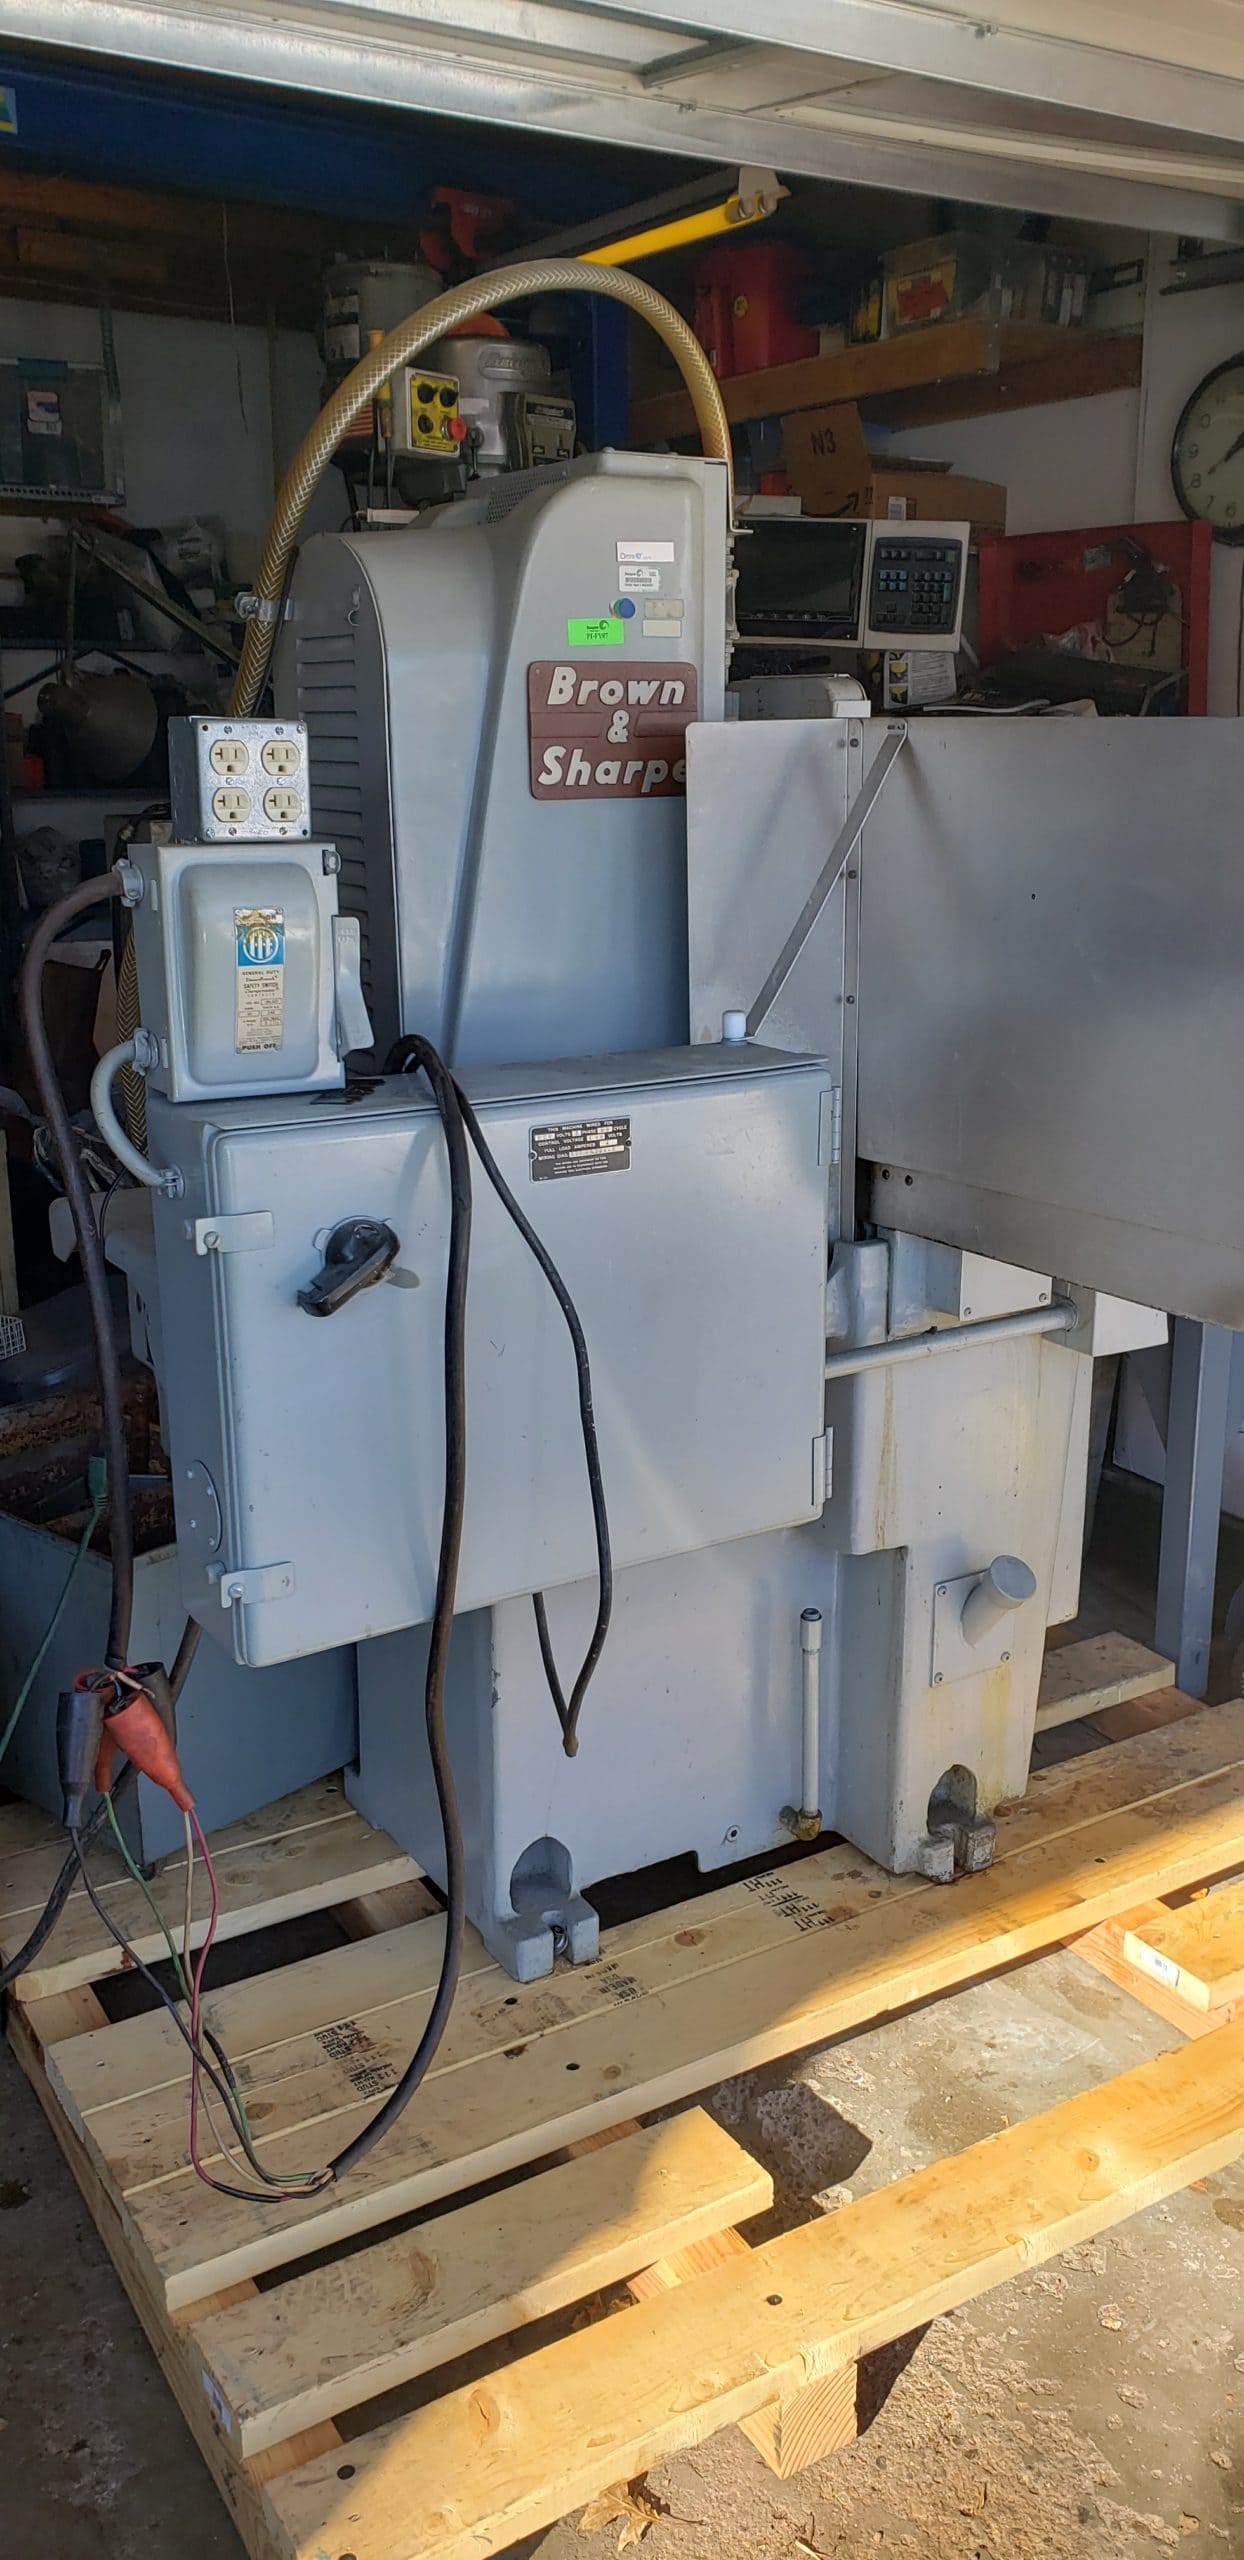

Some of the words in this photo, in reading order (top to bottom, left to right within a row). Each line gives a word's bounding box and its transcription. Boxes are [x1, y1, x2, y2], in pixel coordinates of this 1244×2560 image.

[810, 428, 837, 456] N3
[1190, 473, 1202, 488] 8
[547, 666, 686, 706] Brown
[607, 709, 630, 744] &
[563, 1136, 584, 1144] VOLTAGE
[743, 1878, 765, 1892] HT
[780, 1903, 801, 1917] HT
[794, 1916, 818, 1932] HT
[609, 1976, 638, 1991] MADE
[618, 1987, 638, 2000] USA
[316, 2030, 338, 2041] STUD
[356, 2080, 380, 2092] STUD
